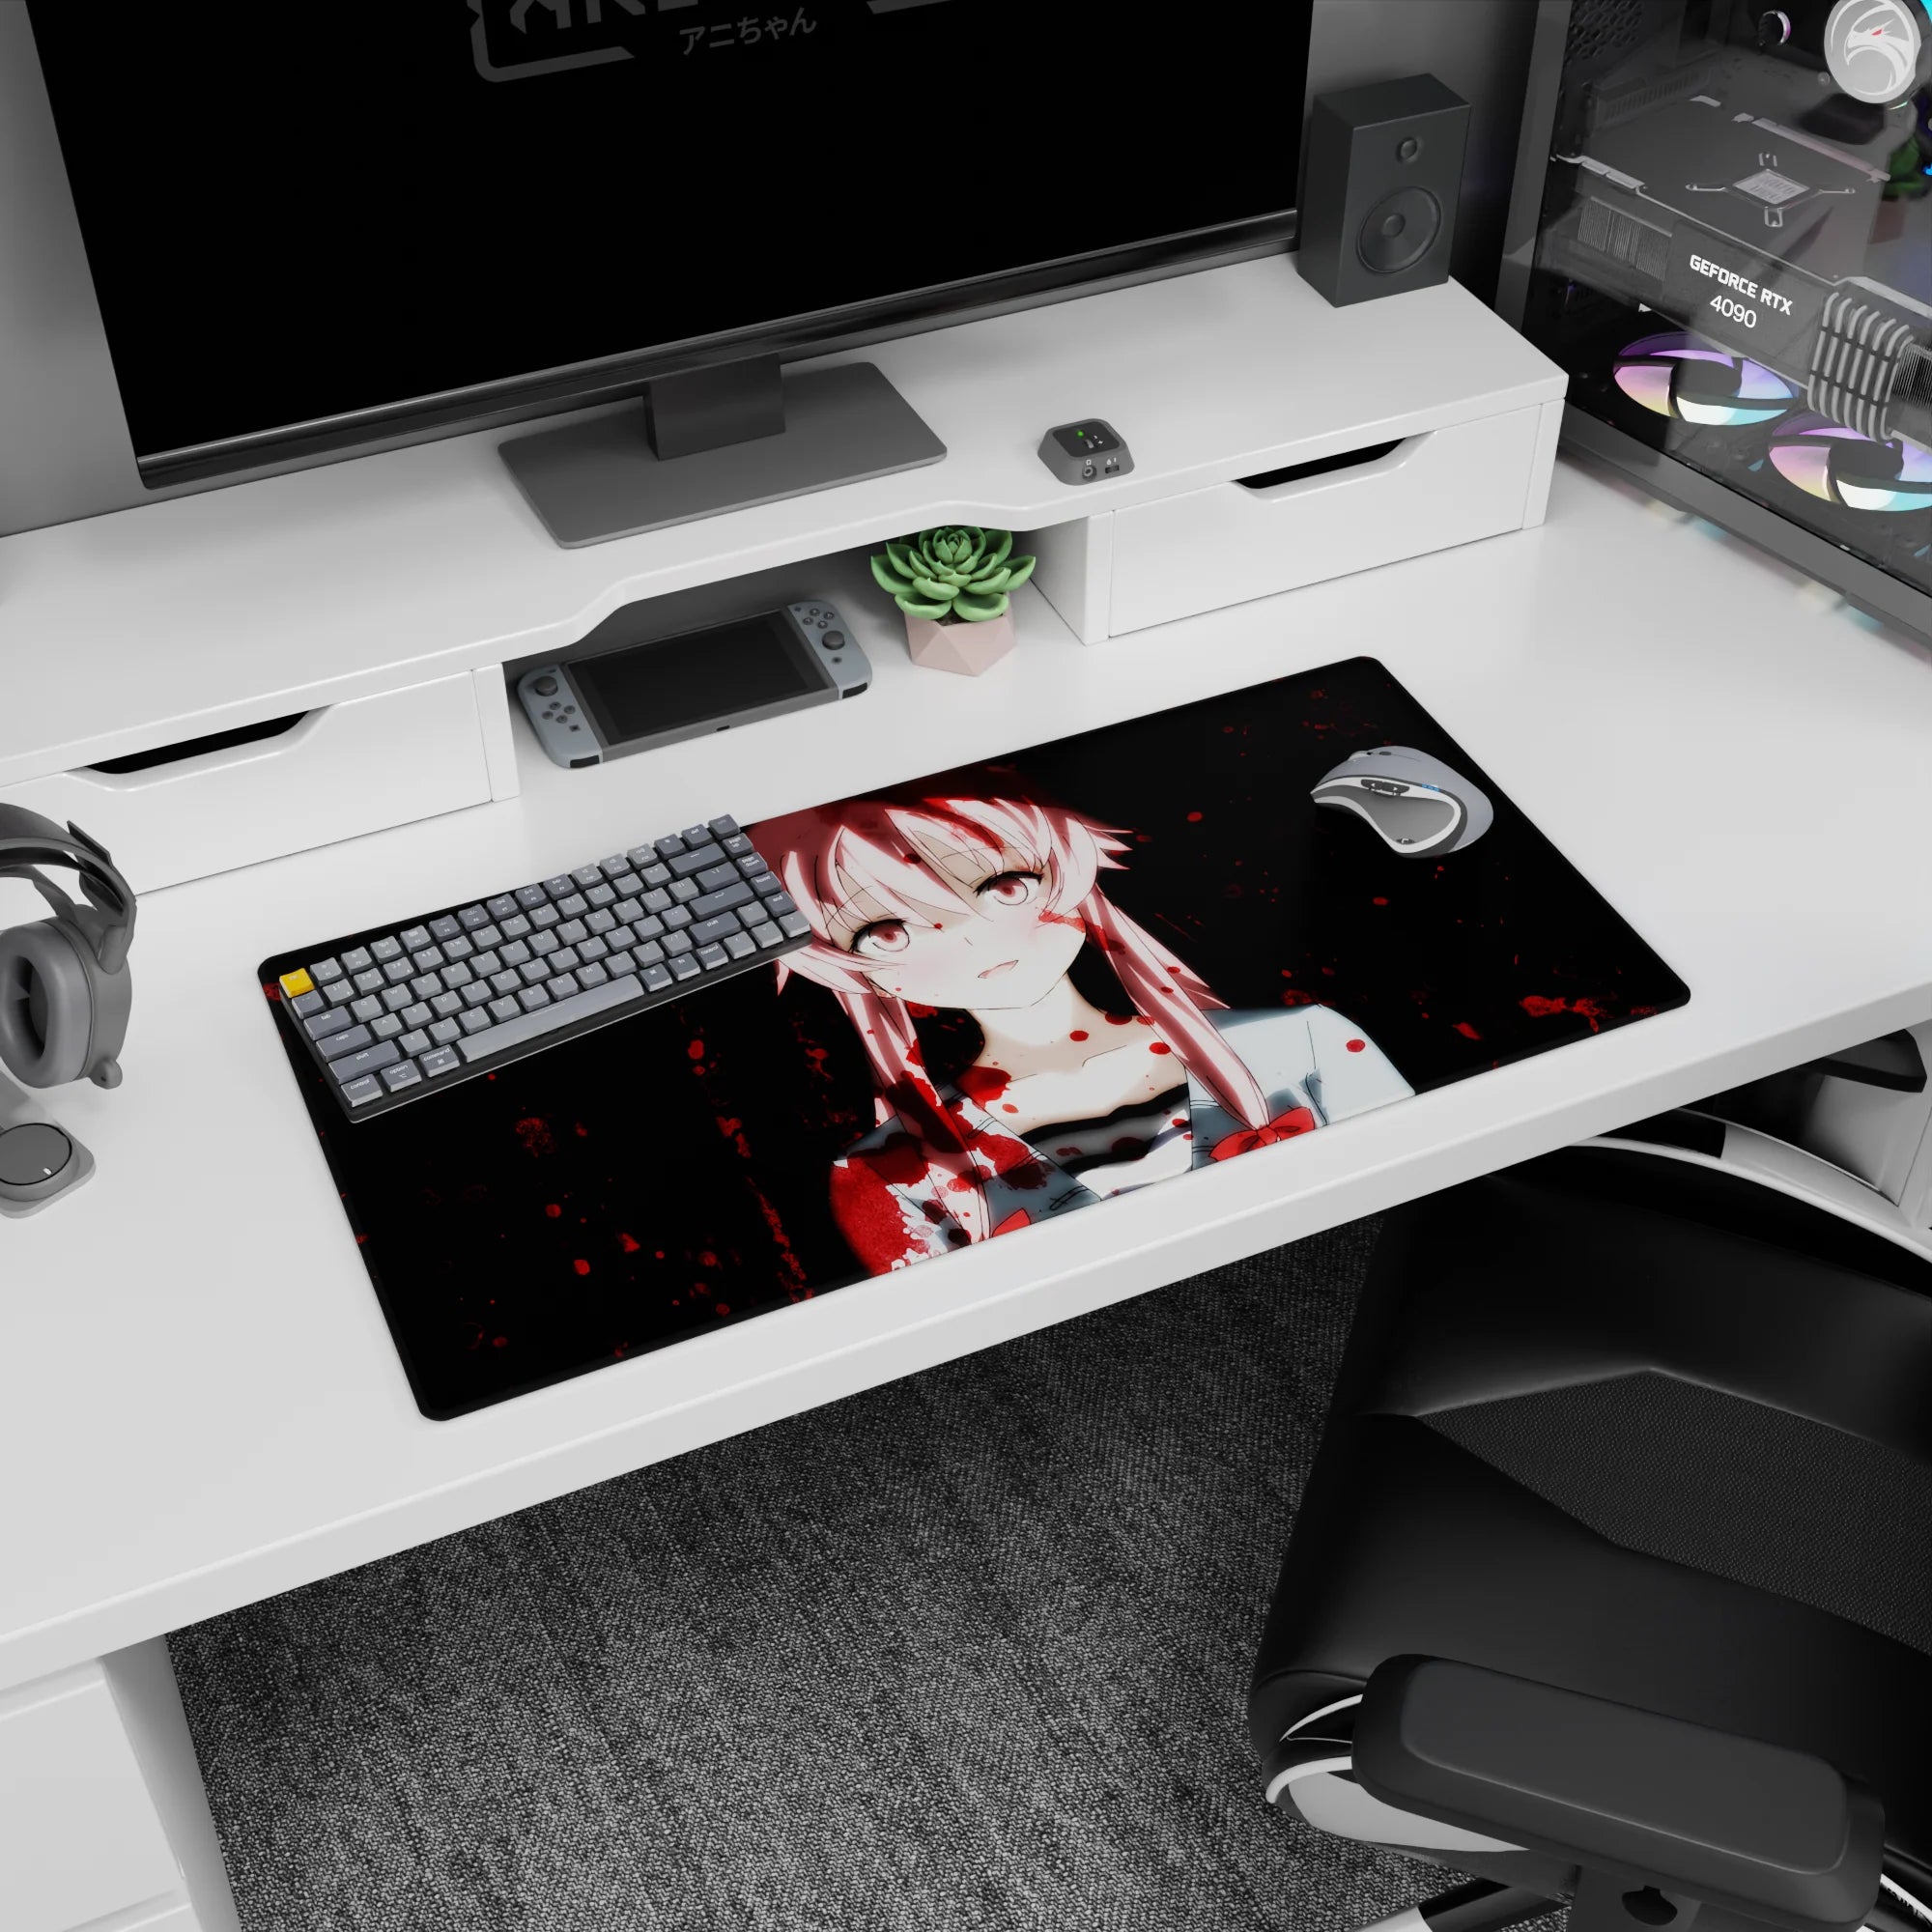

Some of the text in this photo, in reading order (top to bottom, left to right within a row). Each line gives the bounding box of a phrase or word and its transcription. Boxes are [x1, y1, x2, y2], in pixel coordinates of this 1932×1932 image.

[679, 7, 817, 55] アニちゃん
[1690, 254, 1793, 316] GEFORCE RTX
[1710, 295, 1757, 328] 4090
[389, 1065, 408, 1074] option
[423, 1047, 450, 1061] command
